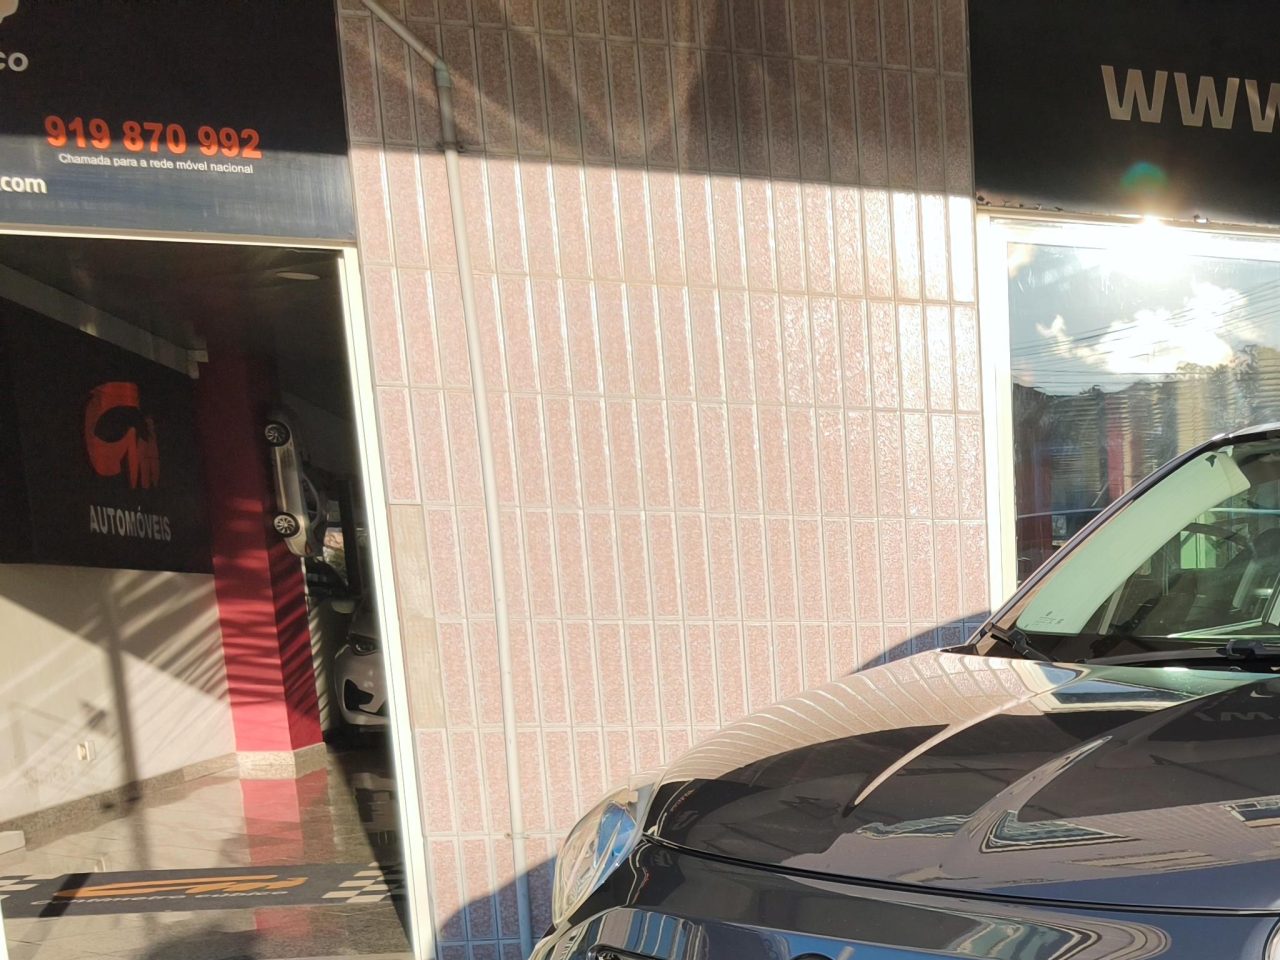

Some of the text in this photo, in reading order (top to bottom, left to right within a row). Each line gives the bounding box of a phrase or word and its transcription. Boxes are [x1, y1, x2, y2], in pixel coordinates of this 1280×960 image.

[44, 115, 263, 159] 919 870 992
[58, 152, 253, 174] Chamada para a rede móvel nacional
[89, 504, 172, 542] AUTOMÓVEIS
